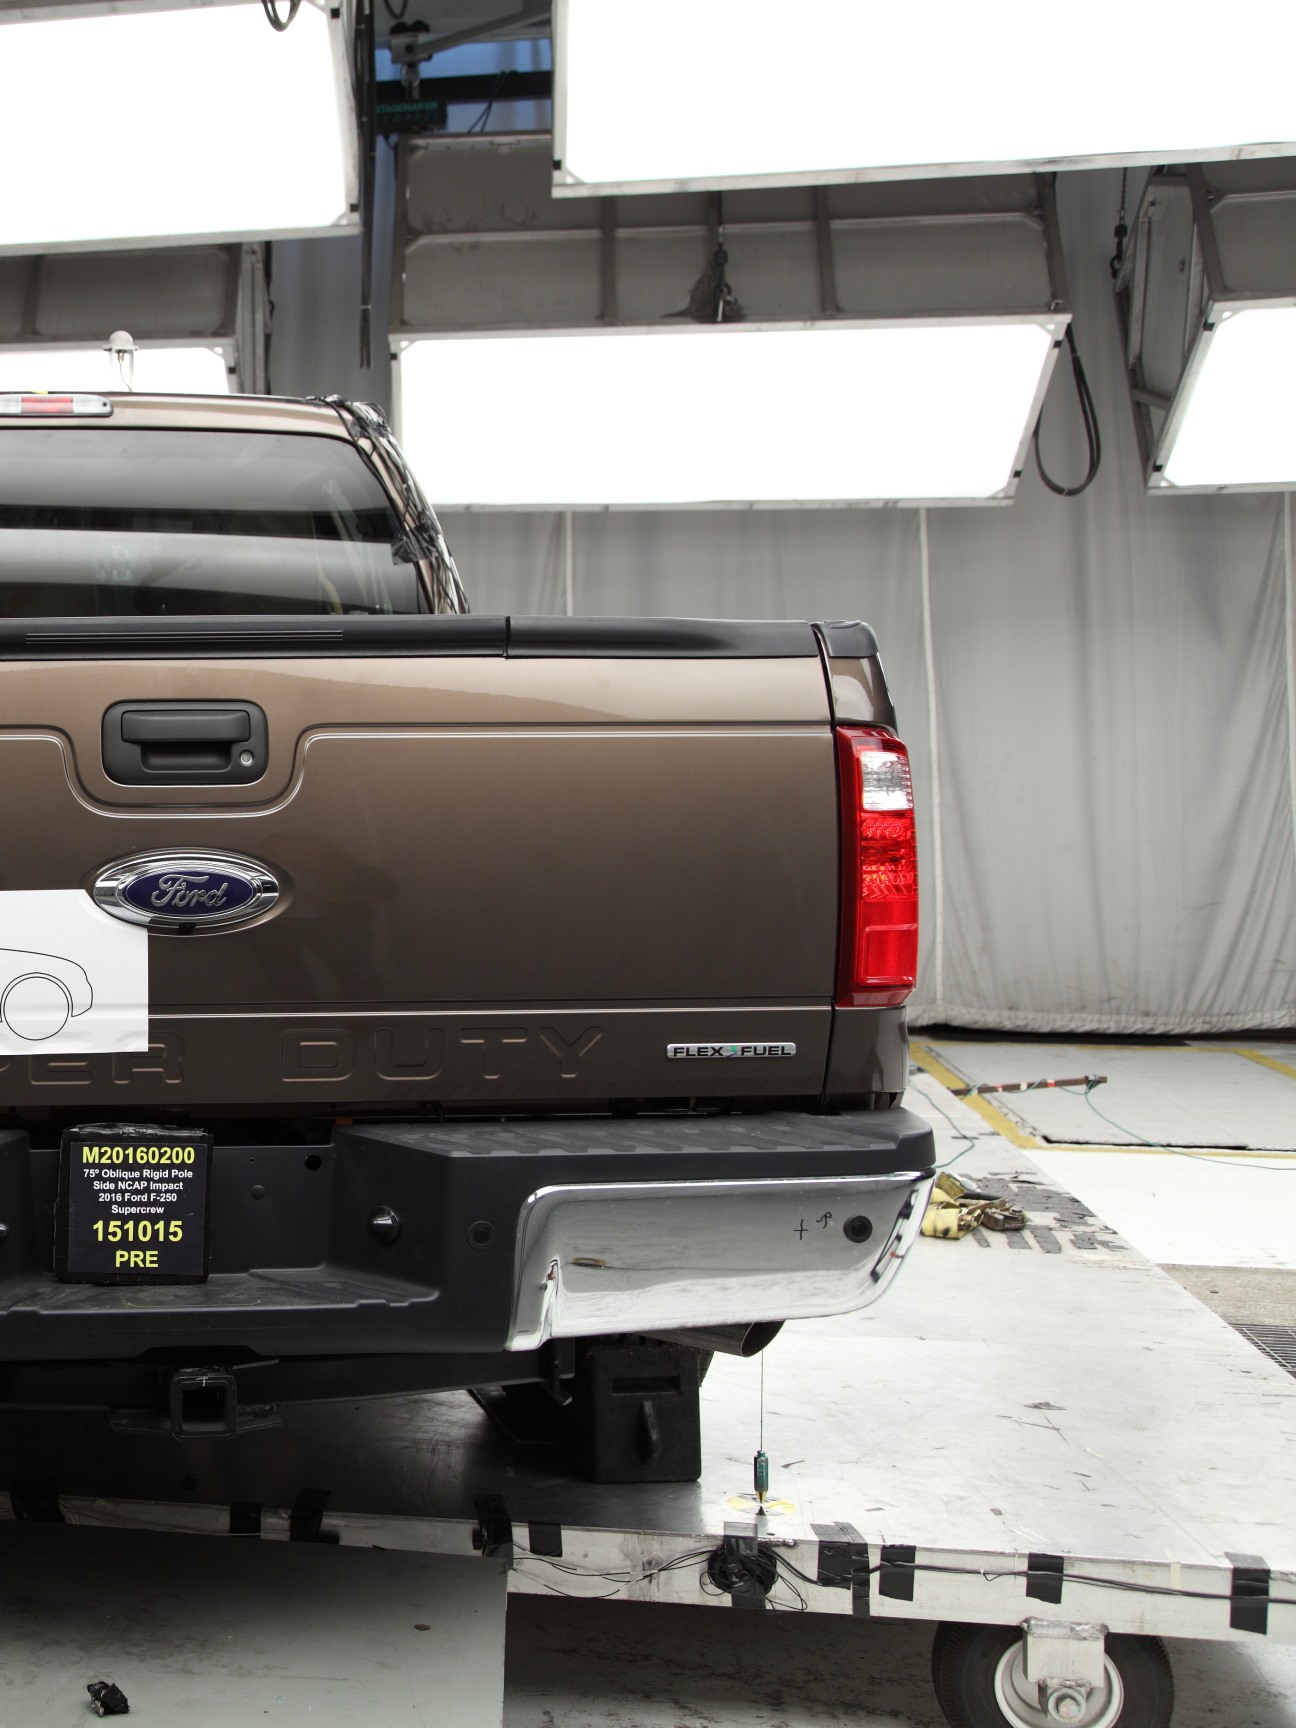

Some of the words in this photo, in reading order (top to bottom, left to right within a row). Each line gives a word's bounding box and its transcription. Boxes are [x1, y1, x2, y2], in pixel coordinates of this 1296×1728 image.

[151, 874, 229, 908] Ford
[281, 1026, 604, 1082] DUTY
[673, 1047, 723, 1056] FLEX
[741, 1046, 791, 1056] FUEL
[83, 1147, 194, 1164] M20160200
[102, 1169, 140, 1180] Oblique
[143, 1169, 168, 1180] Rigid
[172, 1169, 193, 1178] Pole
[93, 1181, 115, 1190] Side
[118, 1181, 147, 1190] NCAP
[150, 1181, 183, 1191] Impact
[99, 1193, 122, 1201] 2016
[125, 1193, 147, 1201] Ford
[151, 1193, 177, 1201] F-250
[112, 1205, 164, 1215] Supercrew
[93, 1220, 182, 1241] 151015
[116, 1250, 158, 1267] PRE
